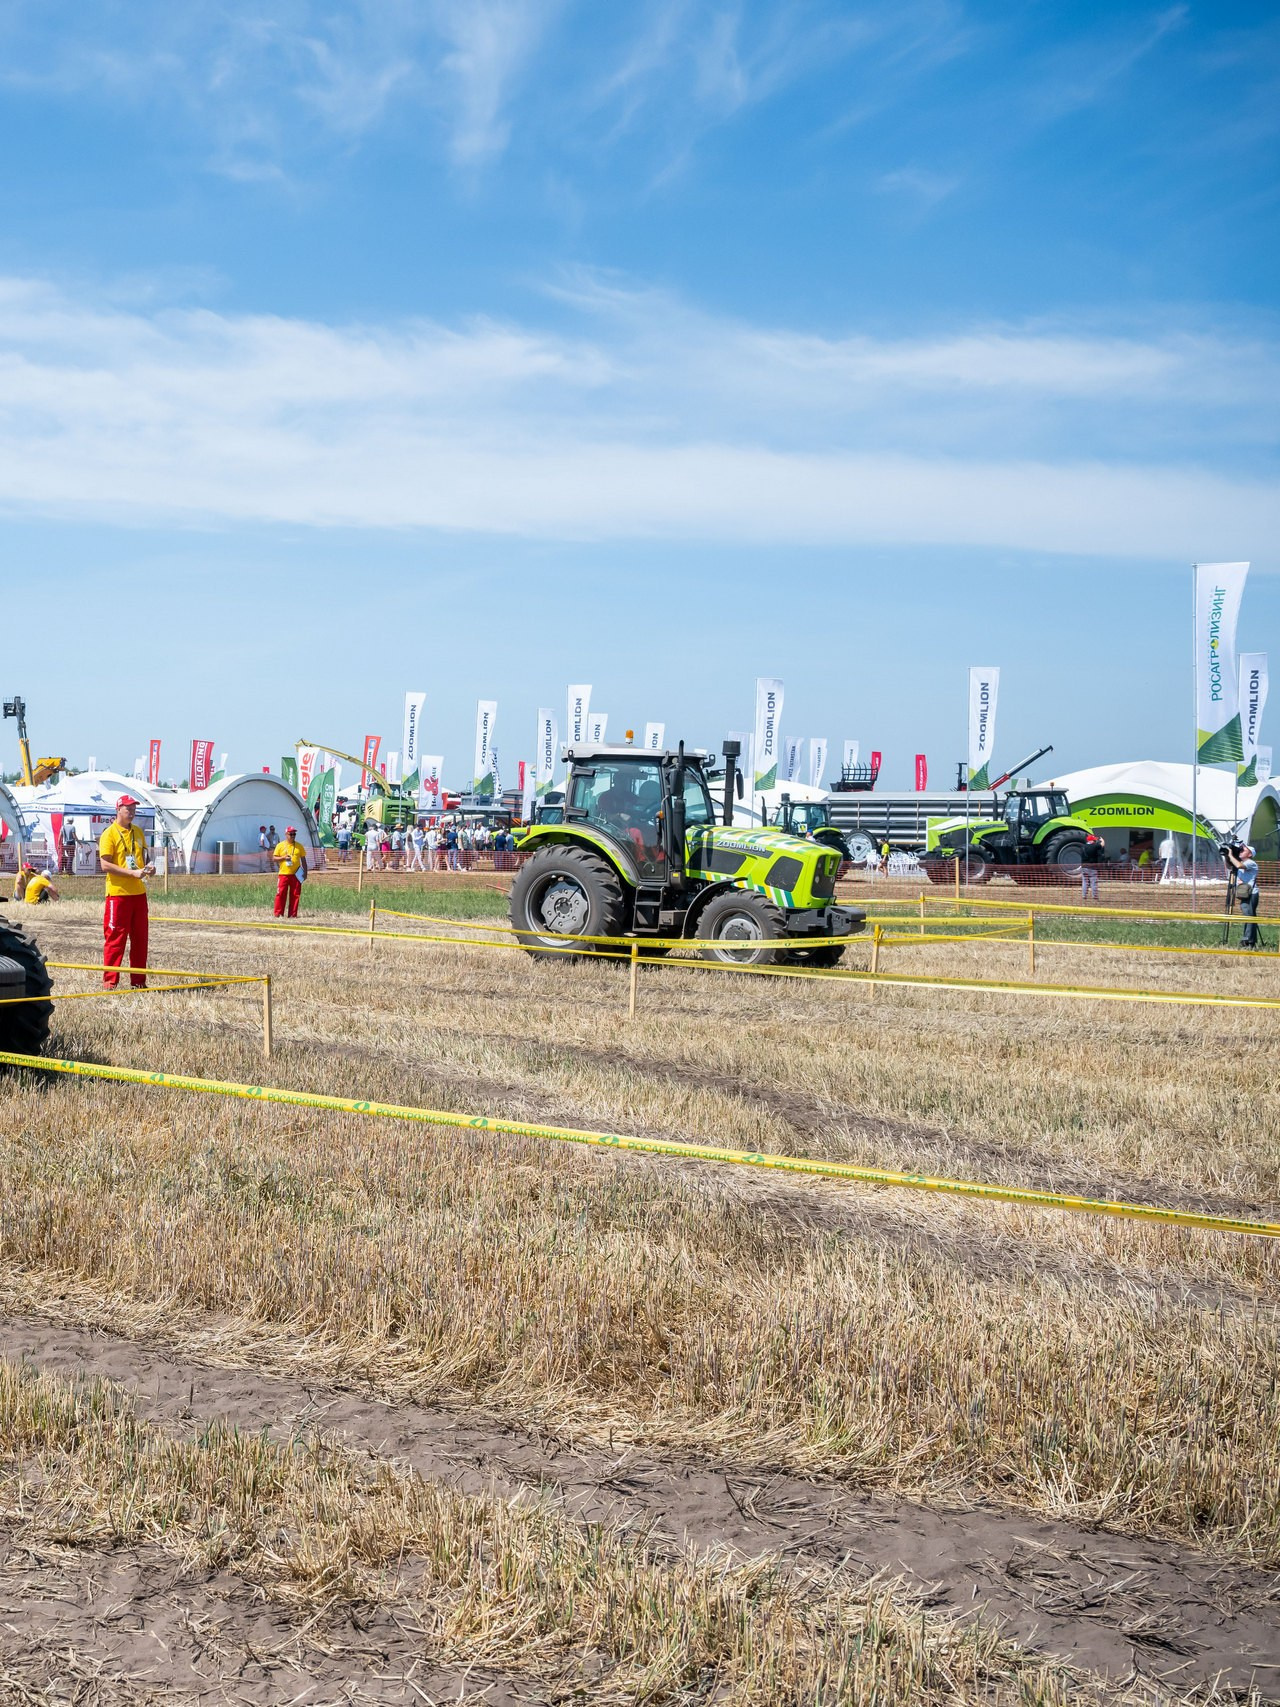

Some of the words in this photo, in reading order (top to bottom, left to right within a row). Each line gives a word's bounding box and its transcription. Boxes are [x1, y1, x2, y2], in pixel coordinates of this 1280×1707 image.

[1211, 585, 1227, 702] РОСАГРОЛИЗИНГ
[408, 704, 417, 761] ZOOMLION
[765, 692, 776, 756] ZOOMLION
[979, 682, 989, 751] ZOOMLION
[1248, 669, 1259, 745] ZOOMLION
[481, 712, 490, 765] ZOOMLION
[1089, 807, 1155, 816] ZOOMLION
[716, 840, 767, 853] ZOOMLION
